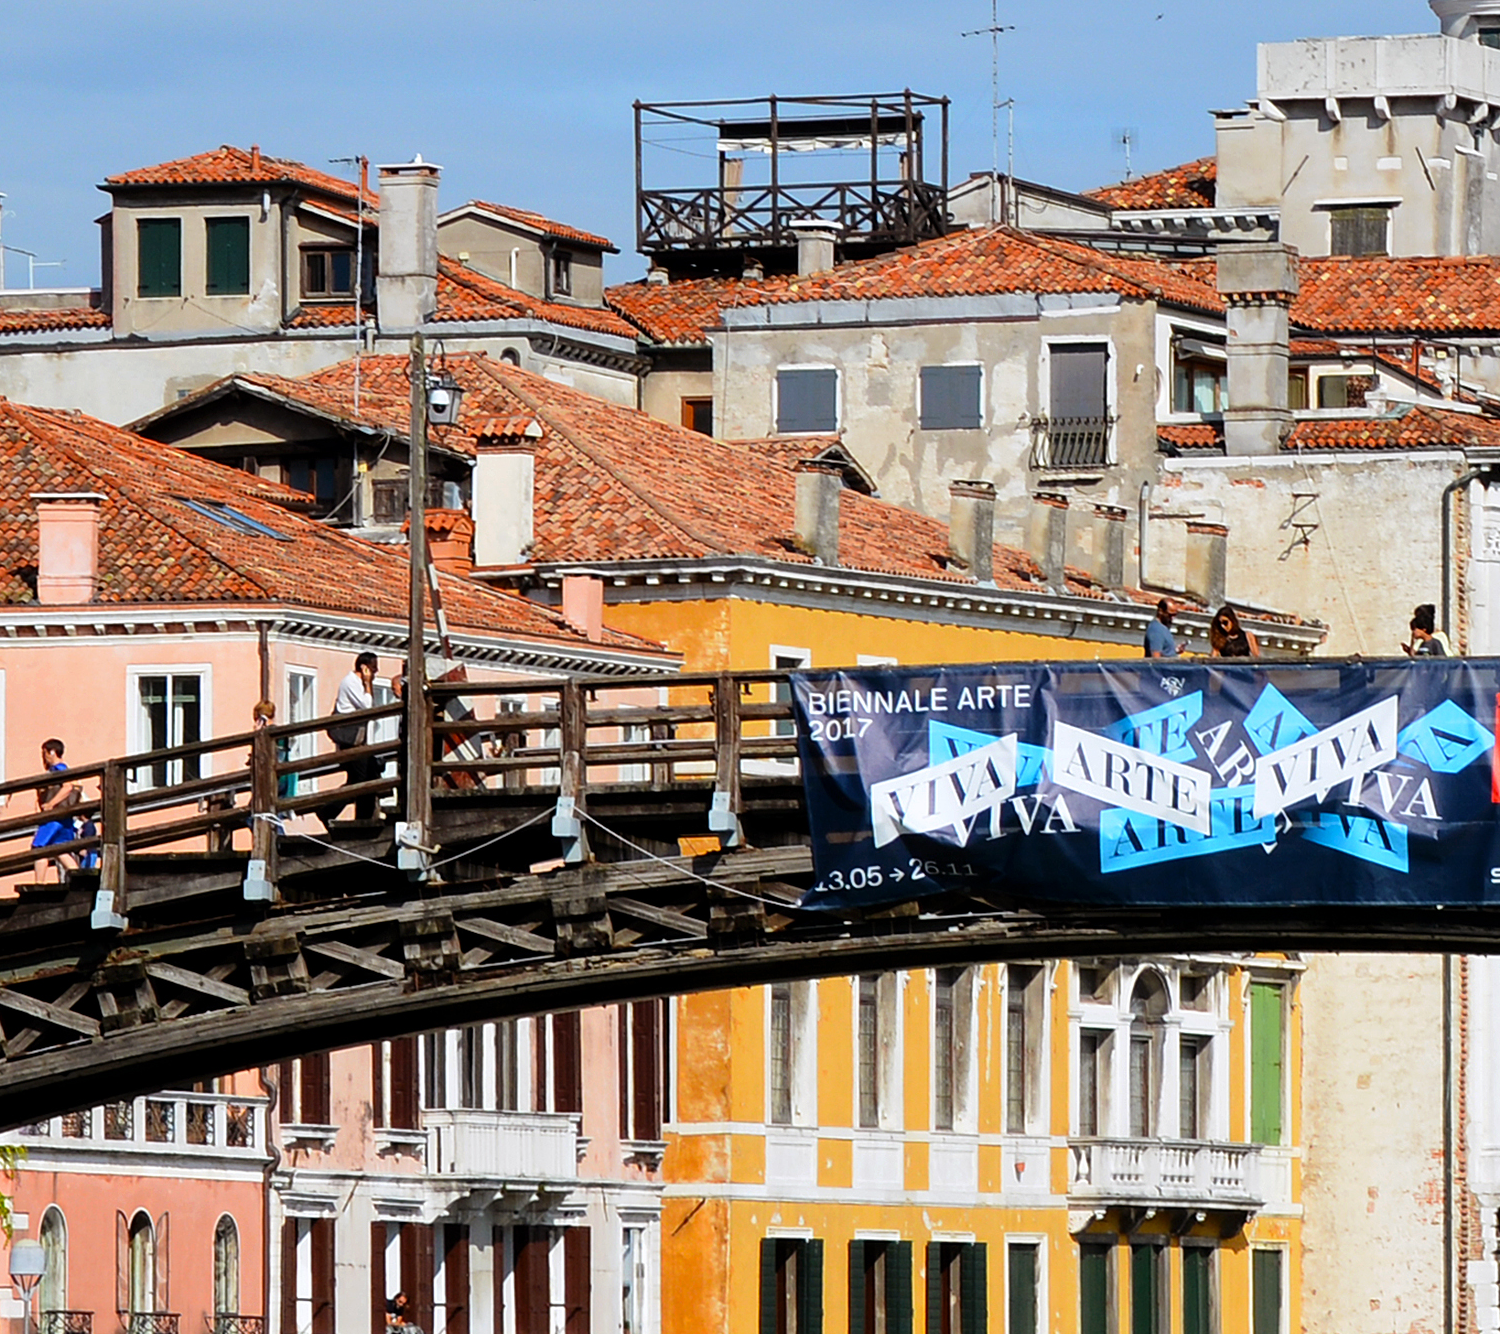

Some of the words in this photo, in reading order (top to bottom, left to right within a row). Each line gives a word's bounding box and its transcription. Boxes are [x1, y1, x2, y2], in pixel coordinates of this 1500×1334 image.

[808, 688, 948, 715] BIENNALE
[957, 685, 1031, 710] ARTE
[809, 718, 873, 742] 2017
[885, 756, 1007, 821] VIVA
[1062, 742, 1199, 816] ARTE
[1270, 719, 1387, 797] VIVA
